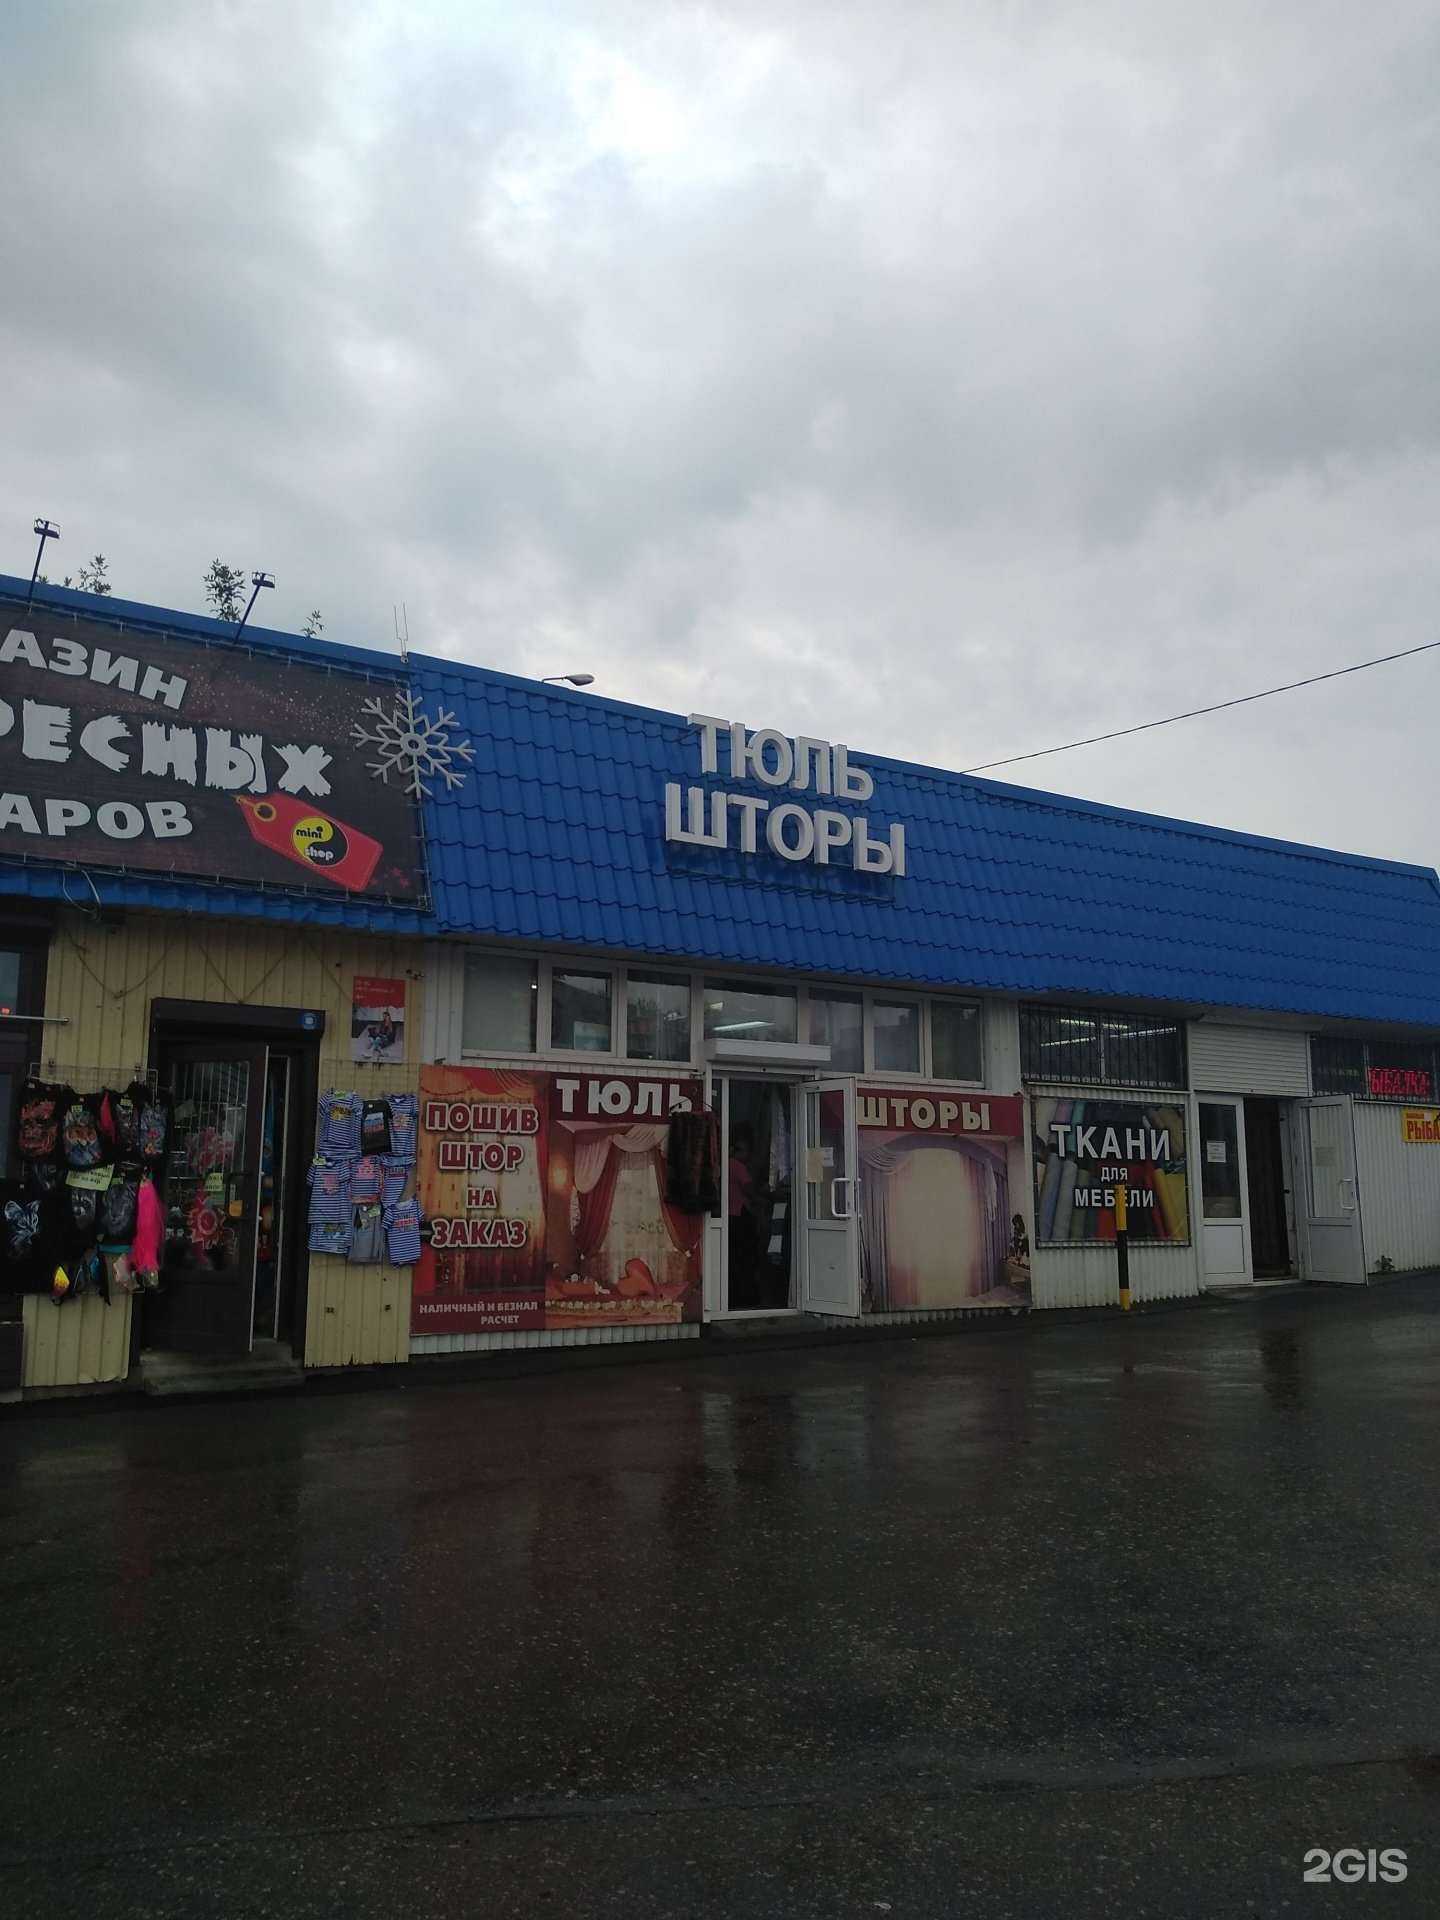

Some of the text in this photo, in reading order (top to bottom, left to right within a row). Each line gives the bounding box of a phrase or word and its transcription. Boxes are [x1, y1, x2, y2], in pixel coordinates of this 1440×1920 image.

[687, 713, 874, 802] ТЮЛЬ
[296, 826, 323, 839] mini
[665, 782, 906, 877] ШТОРЫ
[304, 846, 334, 861] shop
[556, 1078, 692, 1117] ТЮЛЬ
[426, 1102, 540, 1135] ПОШИВ
[857, 1096, 991, 1131] ШТОРЫ
[439, 1141, 525, 1172] ШТОР
[1050, 1123, 1172, 1162] ТКАНИ
[1100, 1166, 1128, 1182] ДЛЯ
[466, 1186, 496, 1209] НА
[431, 1218, 527, 1249] ЗАКАЗ
[419, 1301, 485, 1313] НАЛИЧНЫЙ
[497, 1301, 538, 1311] БЕЗНАЛ
[480, 1315, 520, 1325] РАСЧЕТ
